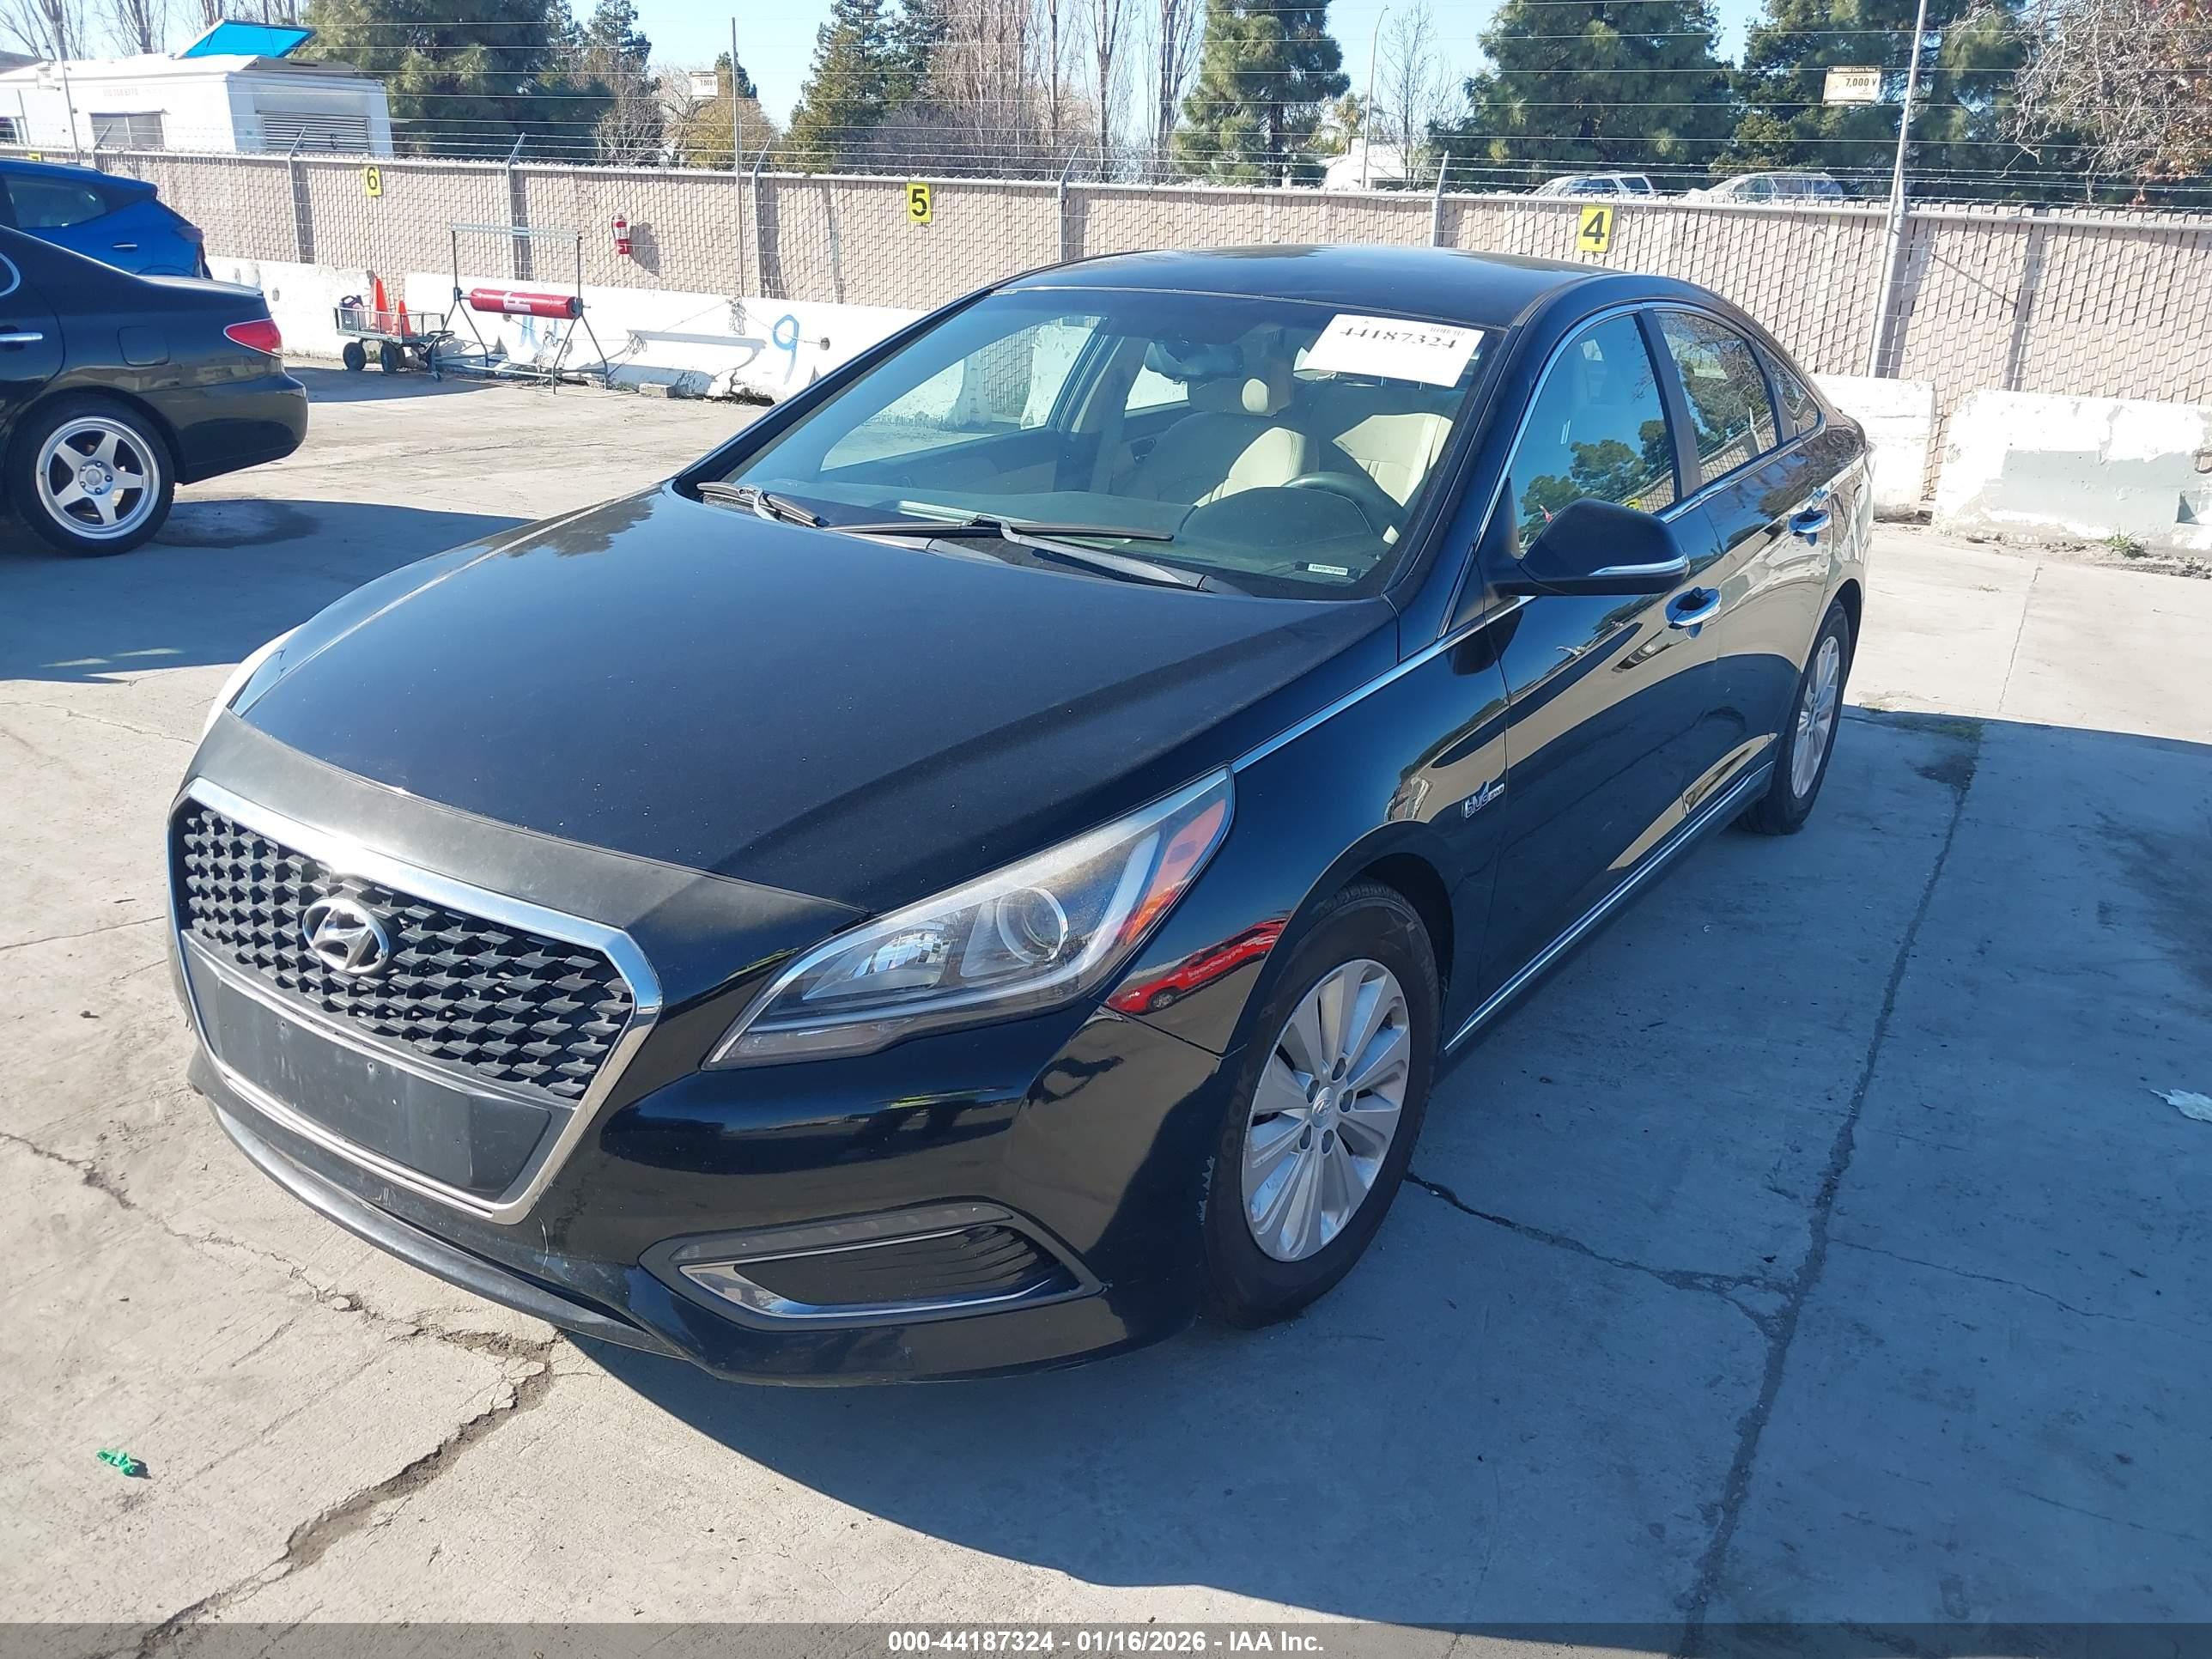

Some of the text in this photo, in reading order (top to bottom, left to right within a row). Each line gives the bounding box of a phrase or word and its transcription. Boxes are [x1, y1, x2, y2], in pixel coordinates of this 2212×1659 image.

[1845, 78, 1878, 88] 7,000 V
[368, 167, 378, 191] 6
[912, 189, 927, 216] 5
[1583, 211, 1605, 245] 4
[773, 314, 799, 385] 9
[1339, 327, 1457, 349] 44187324
